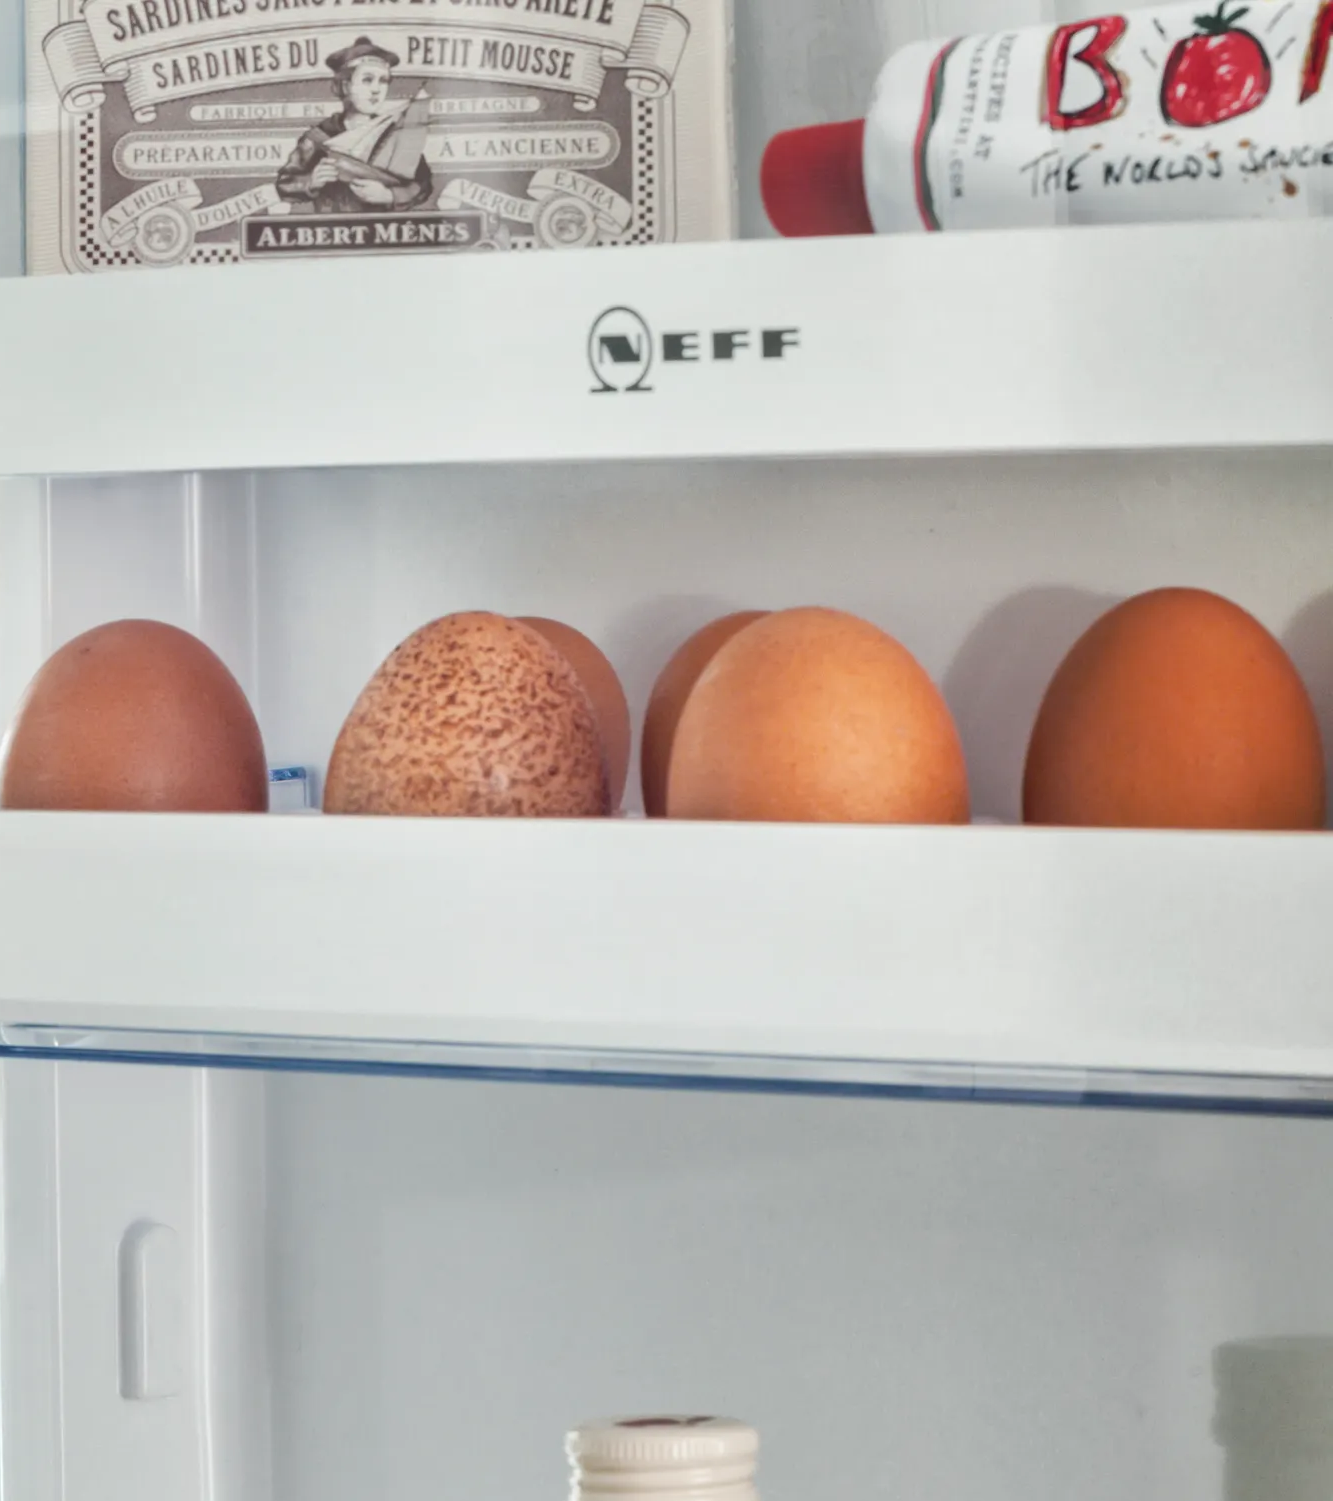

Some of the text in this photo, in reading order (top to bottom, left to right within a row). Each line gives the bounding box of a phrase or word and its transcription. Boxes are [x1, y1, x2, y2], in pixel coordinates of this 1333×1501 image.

[152, 36, 575, 89] SARDINES DU PETIT MOUSSE
[302, 103, 326, 117] EN
[133, 142, 283, 165] PRÉPARATION
[465, 136, 602, 157] L'ANCIENNE
[1020, 147, 1091, 198] THE
[554, 172, 616, 211] EXTRA
[256, 226, 369, 248] ALBERT
